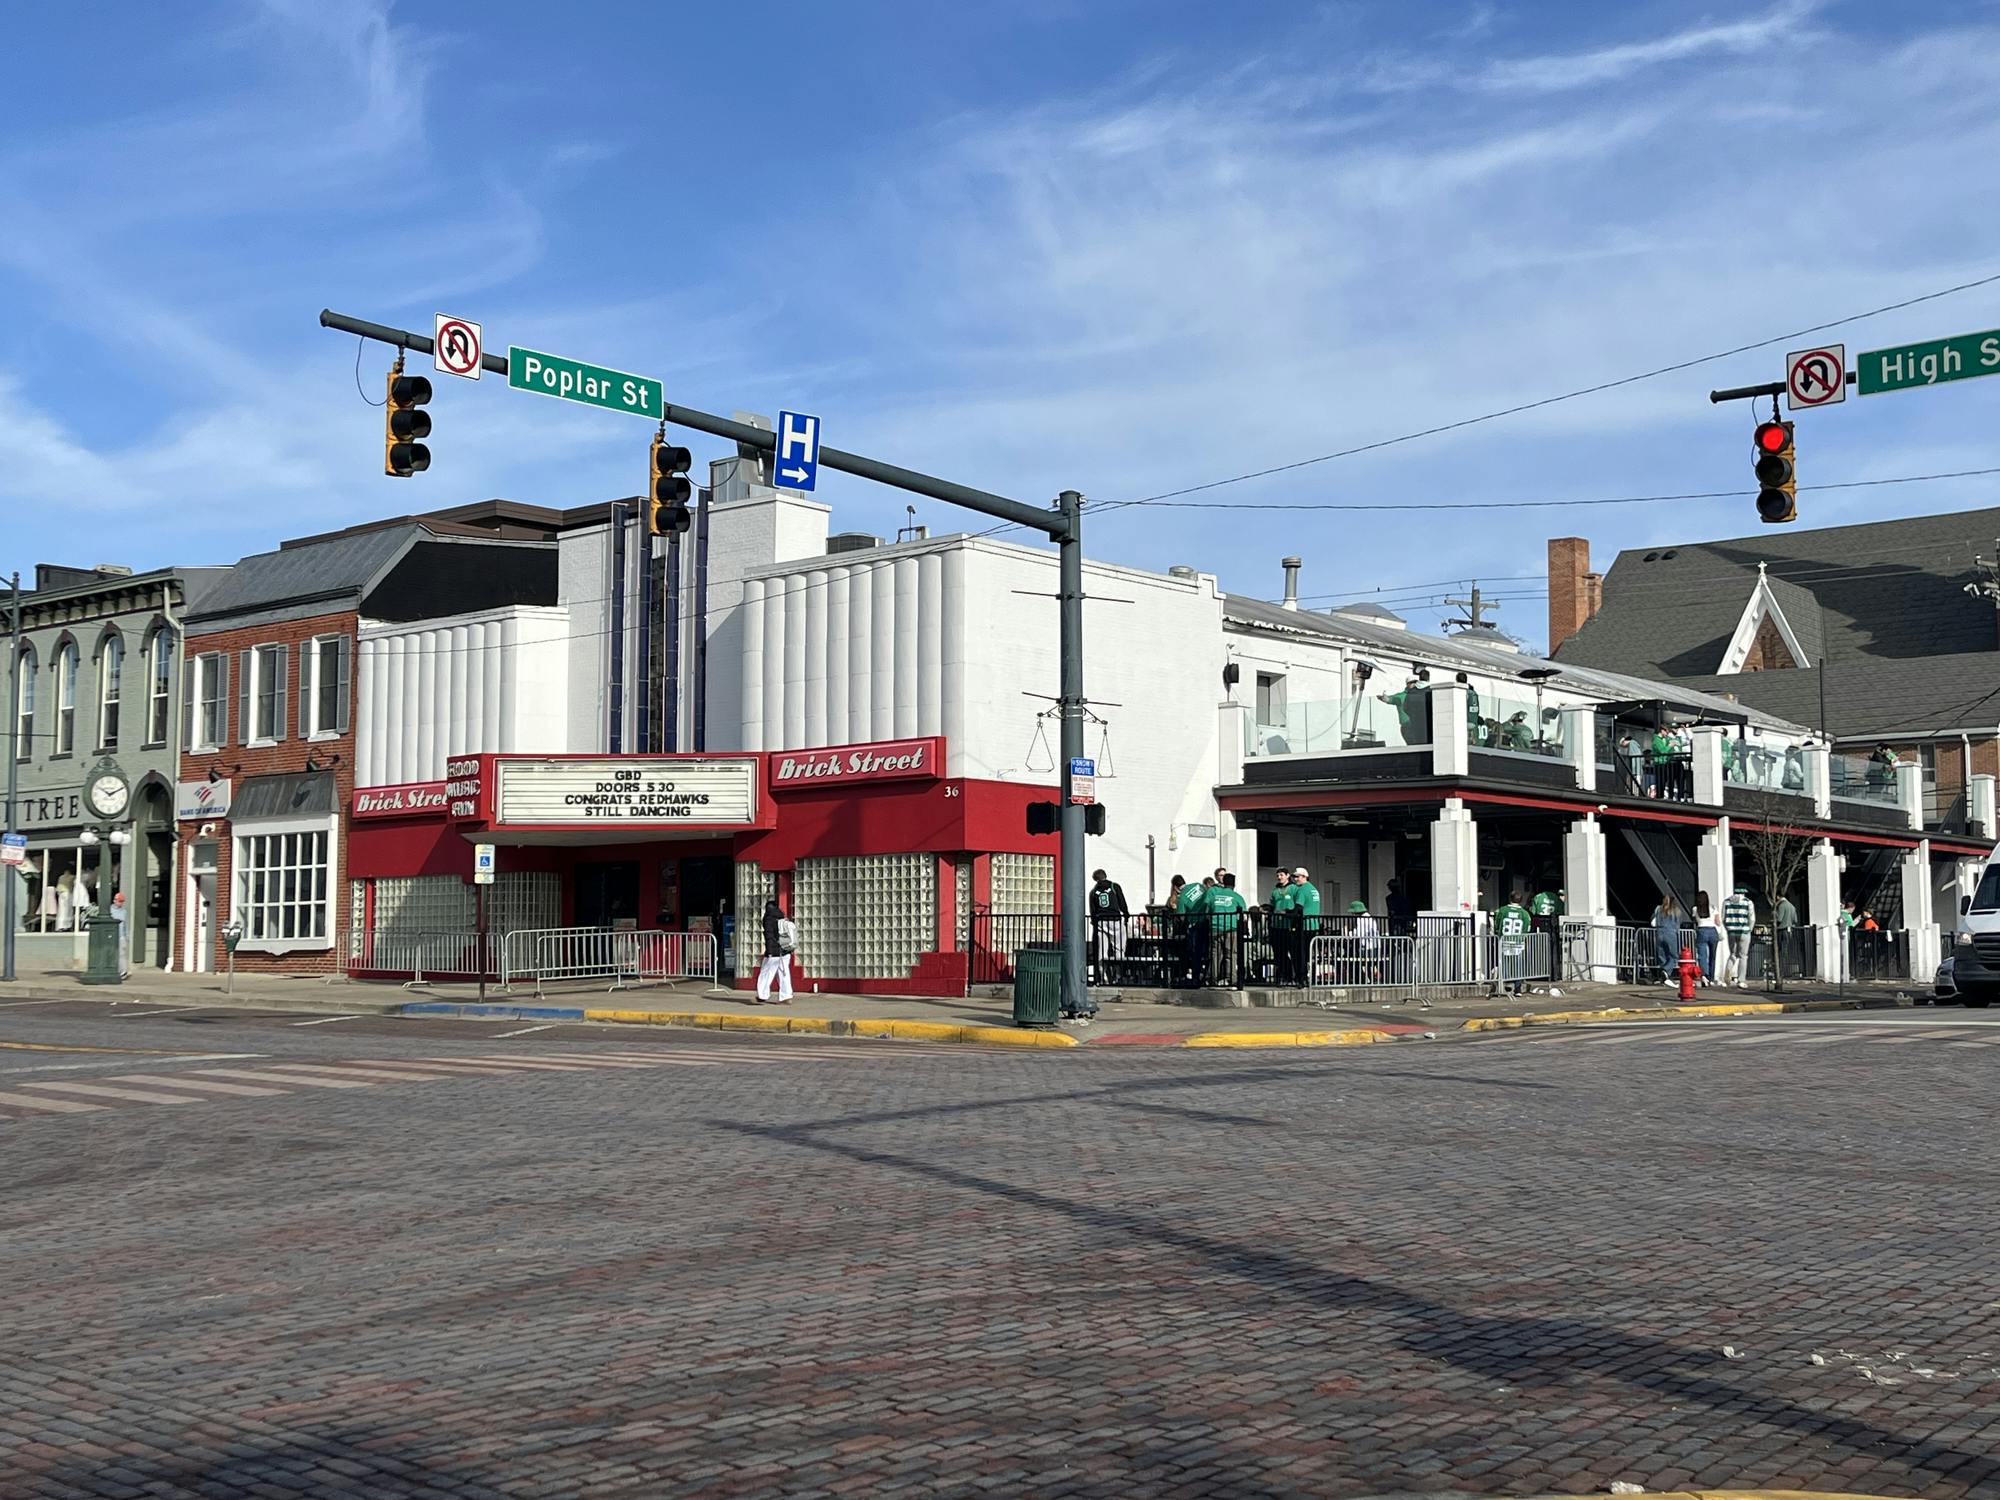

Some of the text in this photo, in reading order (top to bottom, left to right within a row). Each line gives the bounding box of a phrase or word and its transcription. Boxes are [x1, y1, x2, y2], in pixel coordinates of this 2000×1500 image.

[1881, 345, 1961, 384] High
[525, 356, 649, 409] Poplar St
[782, 414, 815, 463] H
[447, 760, 480, 777] FOOD
[777, 746, 925, 780] Brick Street
[615, 770, 642, 781] GBD
[596, 783, 640, 793] DOORS
[944, 786, 960, 798] 36
[24, 795, 80, 821] TREE
[356, 791, 404, 812] Brick
[564, 794, 709, 805] CONGRATS REDHAWKS
[584, 806, 691, 817] STILL DANCING
[1502, 917, 1524, 935] 88
